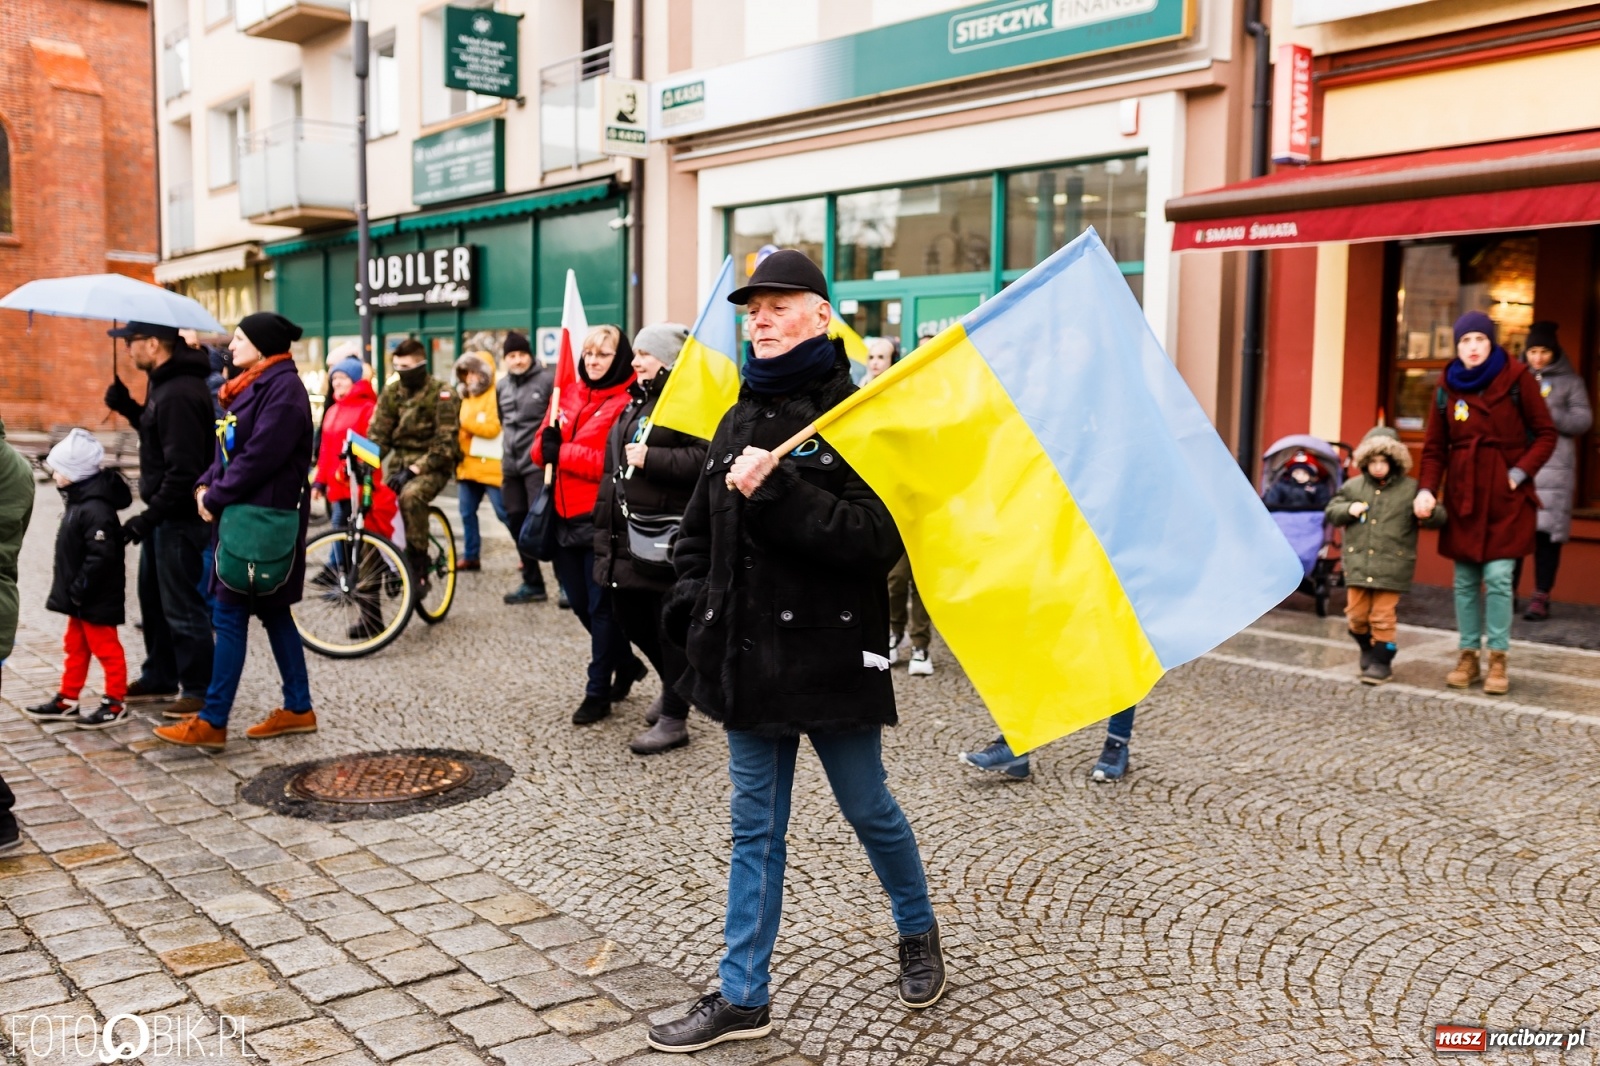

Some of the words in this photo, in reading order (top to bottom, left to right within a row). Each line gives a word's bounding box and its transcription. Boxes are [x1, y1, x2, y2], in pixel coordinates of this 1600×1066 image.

[956, 3, 1049, 43] STEFCZYK
[1205, 225, 1246, 243] SMAKI
[1248, 221, 1298, 240] ŚWIATA
[356, 246, 471, 291] UBILER
